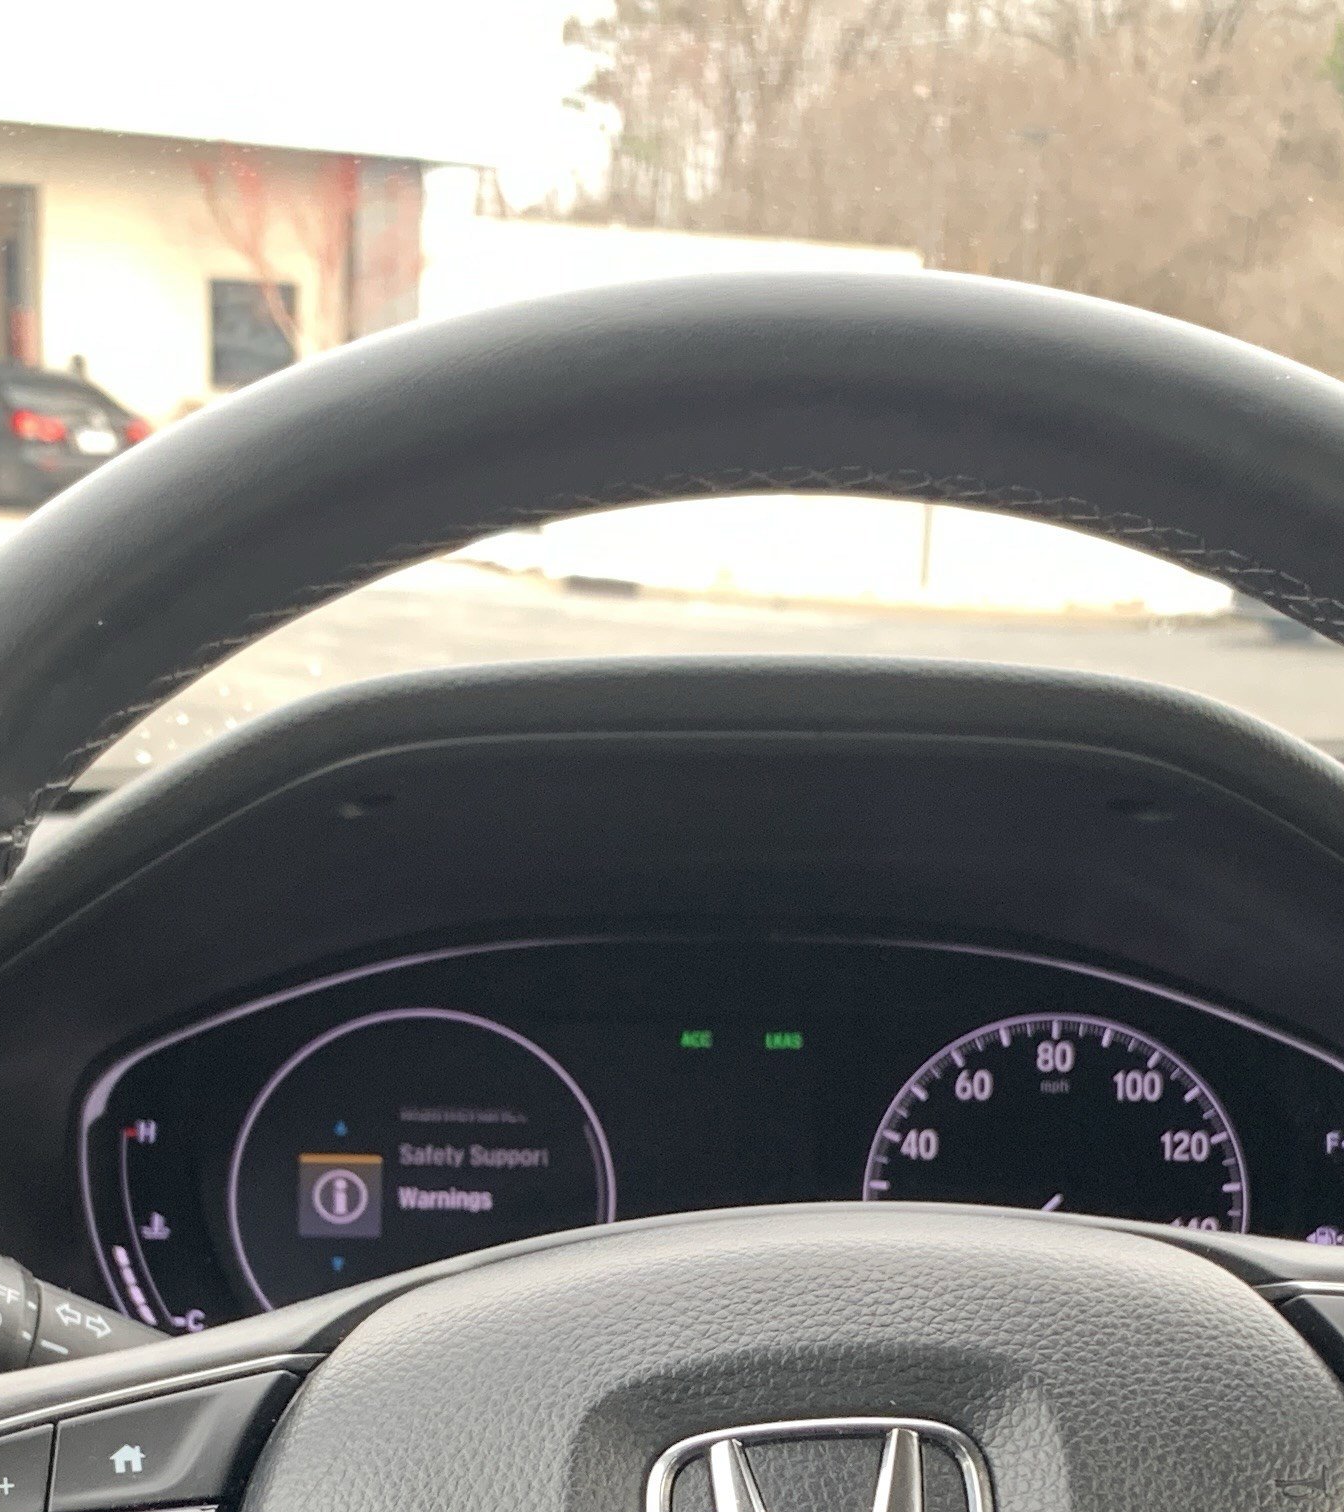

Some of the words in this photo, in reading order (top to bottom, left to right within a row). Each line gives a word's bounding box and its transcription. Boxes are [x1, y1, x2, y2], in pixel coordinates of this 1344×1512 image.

[1037, 1041, 1074, 1074] 80
[956, 1070, 992, 1101] 60
[1113, 1071, 1162, 1102] 100
[901, 1128, 938, 1161] 40
[1161, 1130, 1209, 1162] 120
[1326, 1132, 1341, 1153] F
[398, 1186, 493, 1212] Warnings
